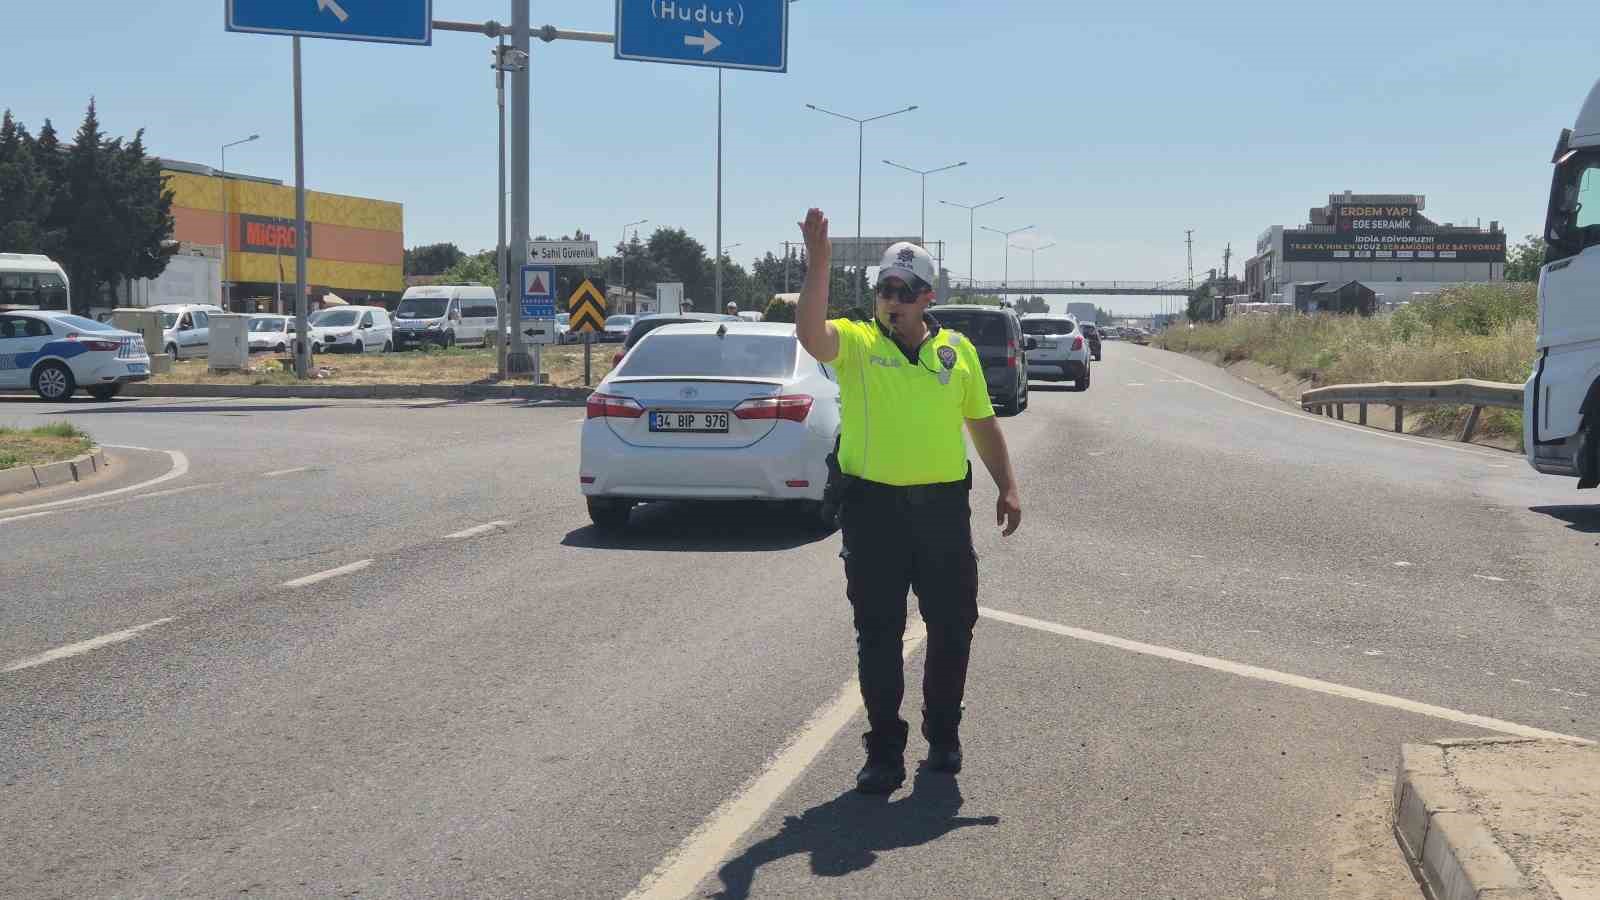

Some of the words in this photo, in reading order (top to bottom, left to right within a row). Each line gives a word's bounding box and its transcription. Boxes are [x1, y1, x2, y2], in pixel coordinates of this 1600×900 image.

[651, 0, 744, 26] (Hudut)
[1343, 207, 1382, 217] ERDEM
[1385, 207, 1413, 217] YAPI
[1352, 219, 1370, 229] EGE
[542, 247, 560, 258] Sahil
[562, 247, 593, 258] Güvenlik
[656, 414, 671, 428] 34
[678, 414, 695, 428] BIP
[704, 414, 726, 428] 976
